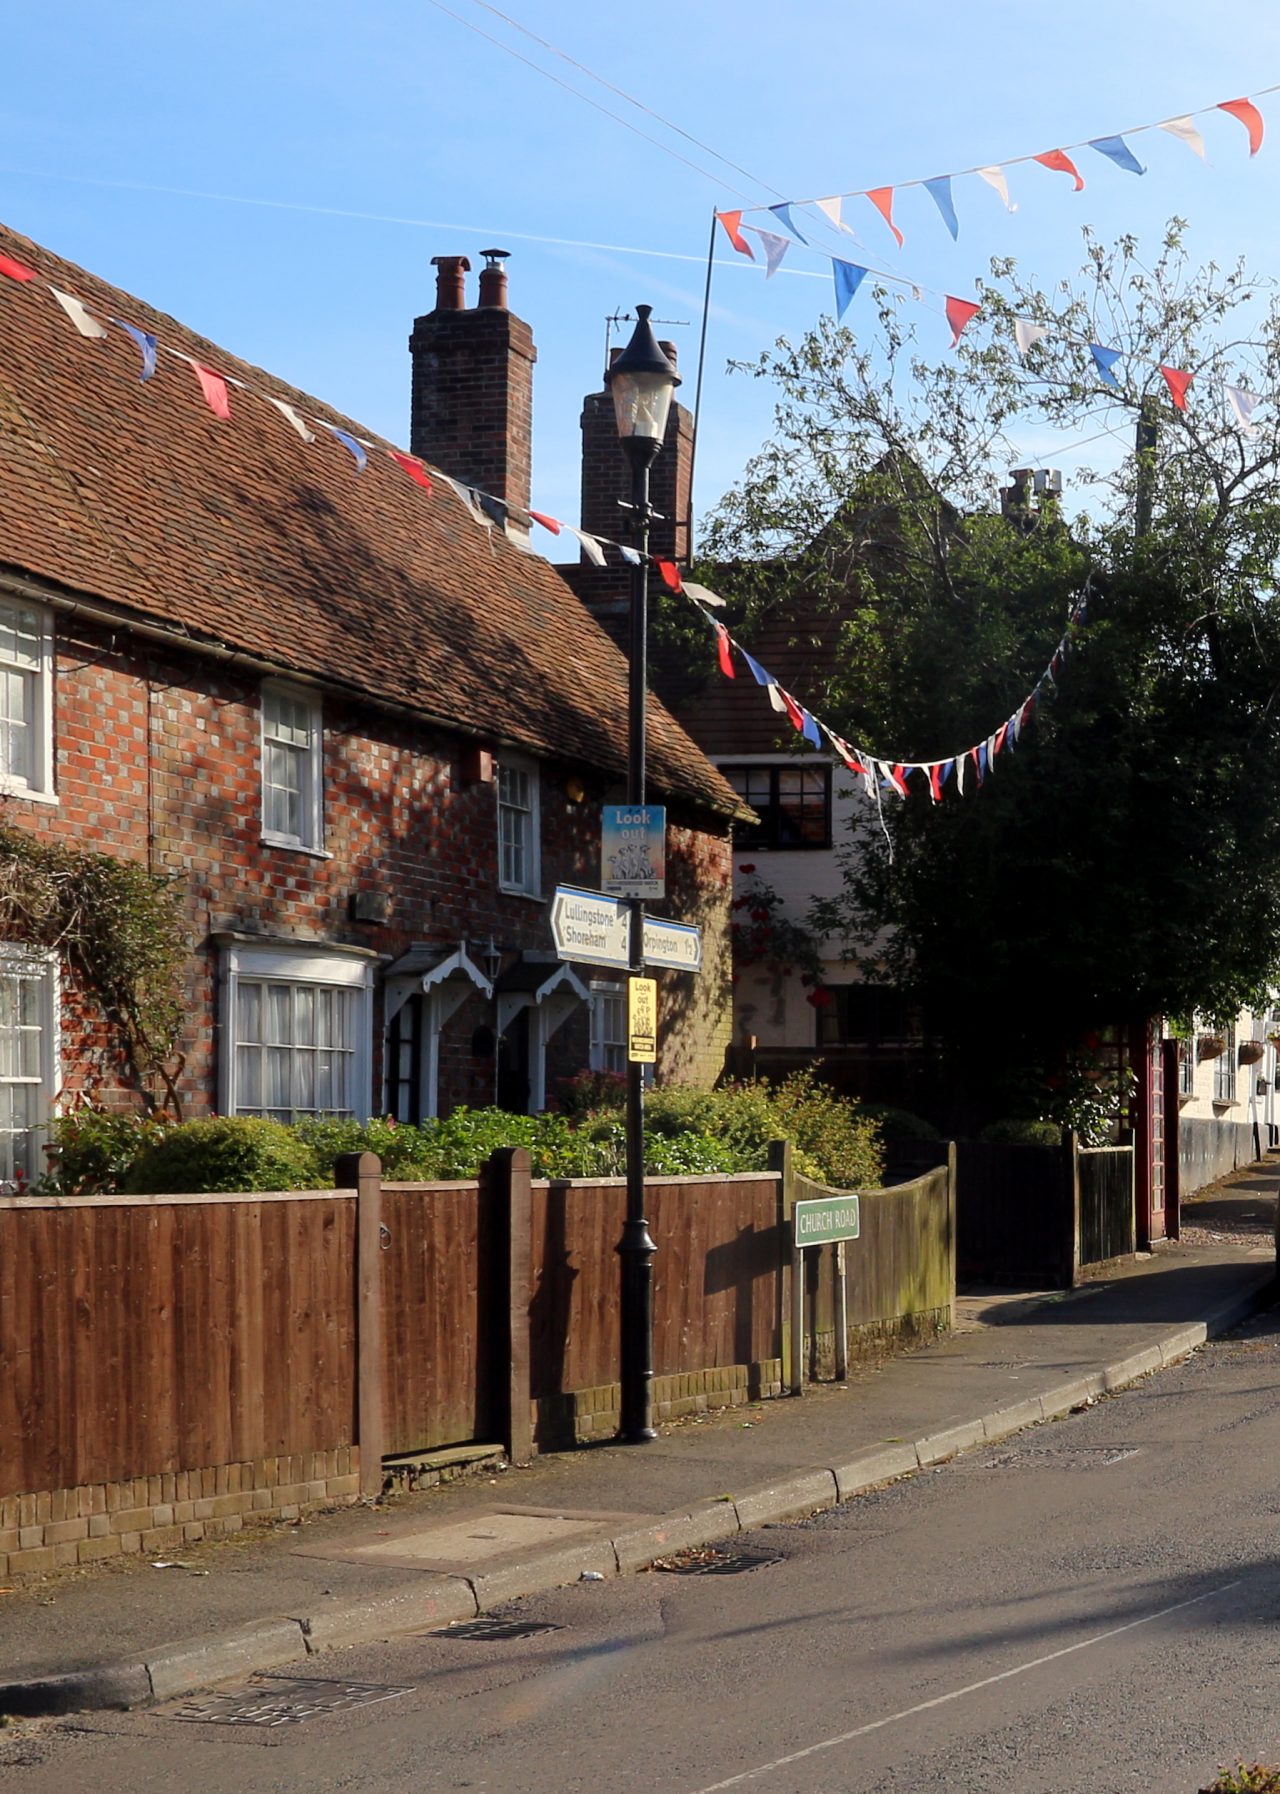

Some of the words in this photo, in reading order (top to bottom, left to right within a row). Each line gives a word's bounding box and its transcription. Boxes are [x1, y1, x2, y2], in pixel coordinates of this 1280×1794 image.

[616, 809, 650, 824] Look
[622, 826, 645, 839] out
[565, 901, 614, 927] Lullingstone
[566, 926, 606, 949] Shoreham
[621, 935, 627, 952] 4
[643, 932, 678, 954] Orpington
[634, 981, 651, 992] Look
[637, 996, 648, 1005] out
[800, 1211, 833, 1234] CHURCH
[835, 1208, 856, 1229] ROAD
